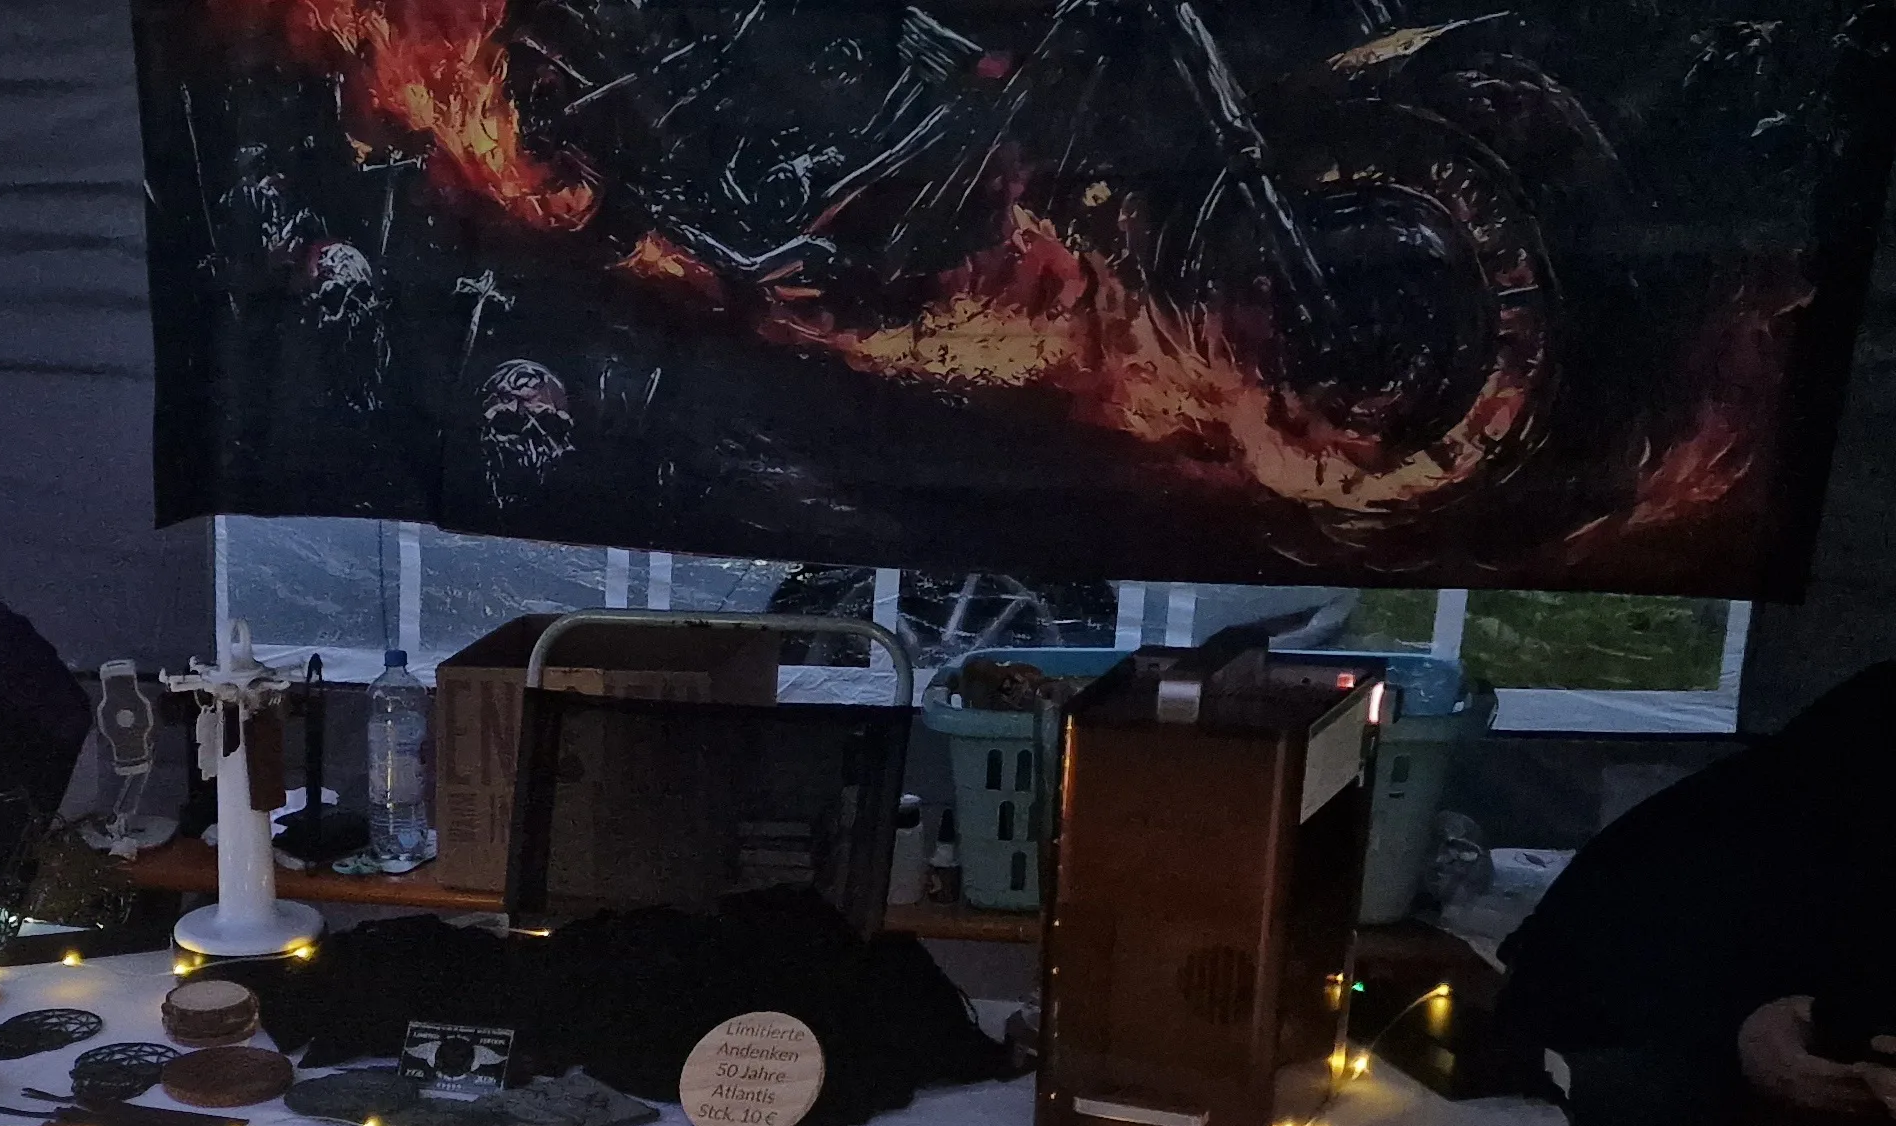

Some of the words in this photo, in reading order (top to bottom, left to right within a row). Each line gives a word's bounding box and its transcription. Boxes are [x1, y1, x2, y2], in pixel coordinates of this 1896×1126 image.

[725, 1021, 805, 1042] Limitierte
[716, 1042, 800, 1063] Andenken
[715, 1063, 738, 1078] 50
[739, 1066, 786, 1083] Jahre
[711, 1084, 776, 1104] Atlantis
[698, 1103, 734, 1122] Stck.
[740, 1108, 762, 1124] 10
[764, 1111, 778, 1126] €
